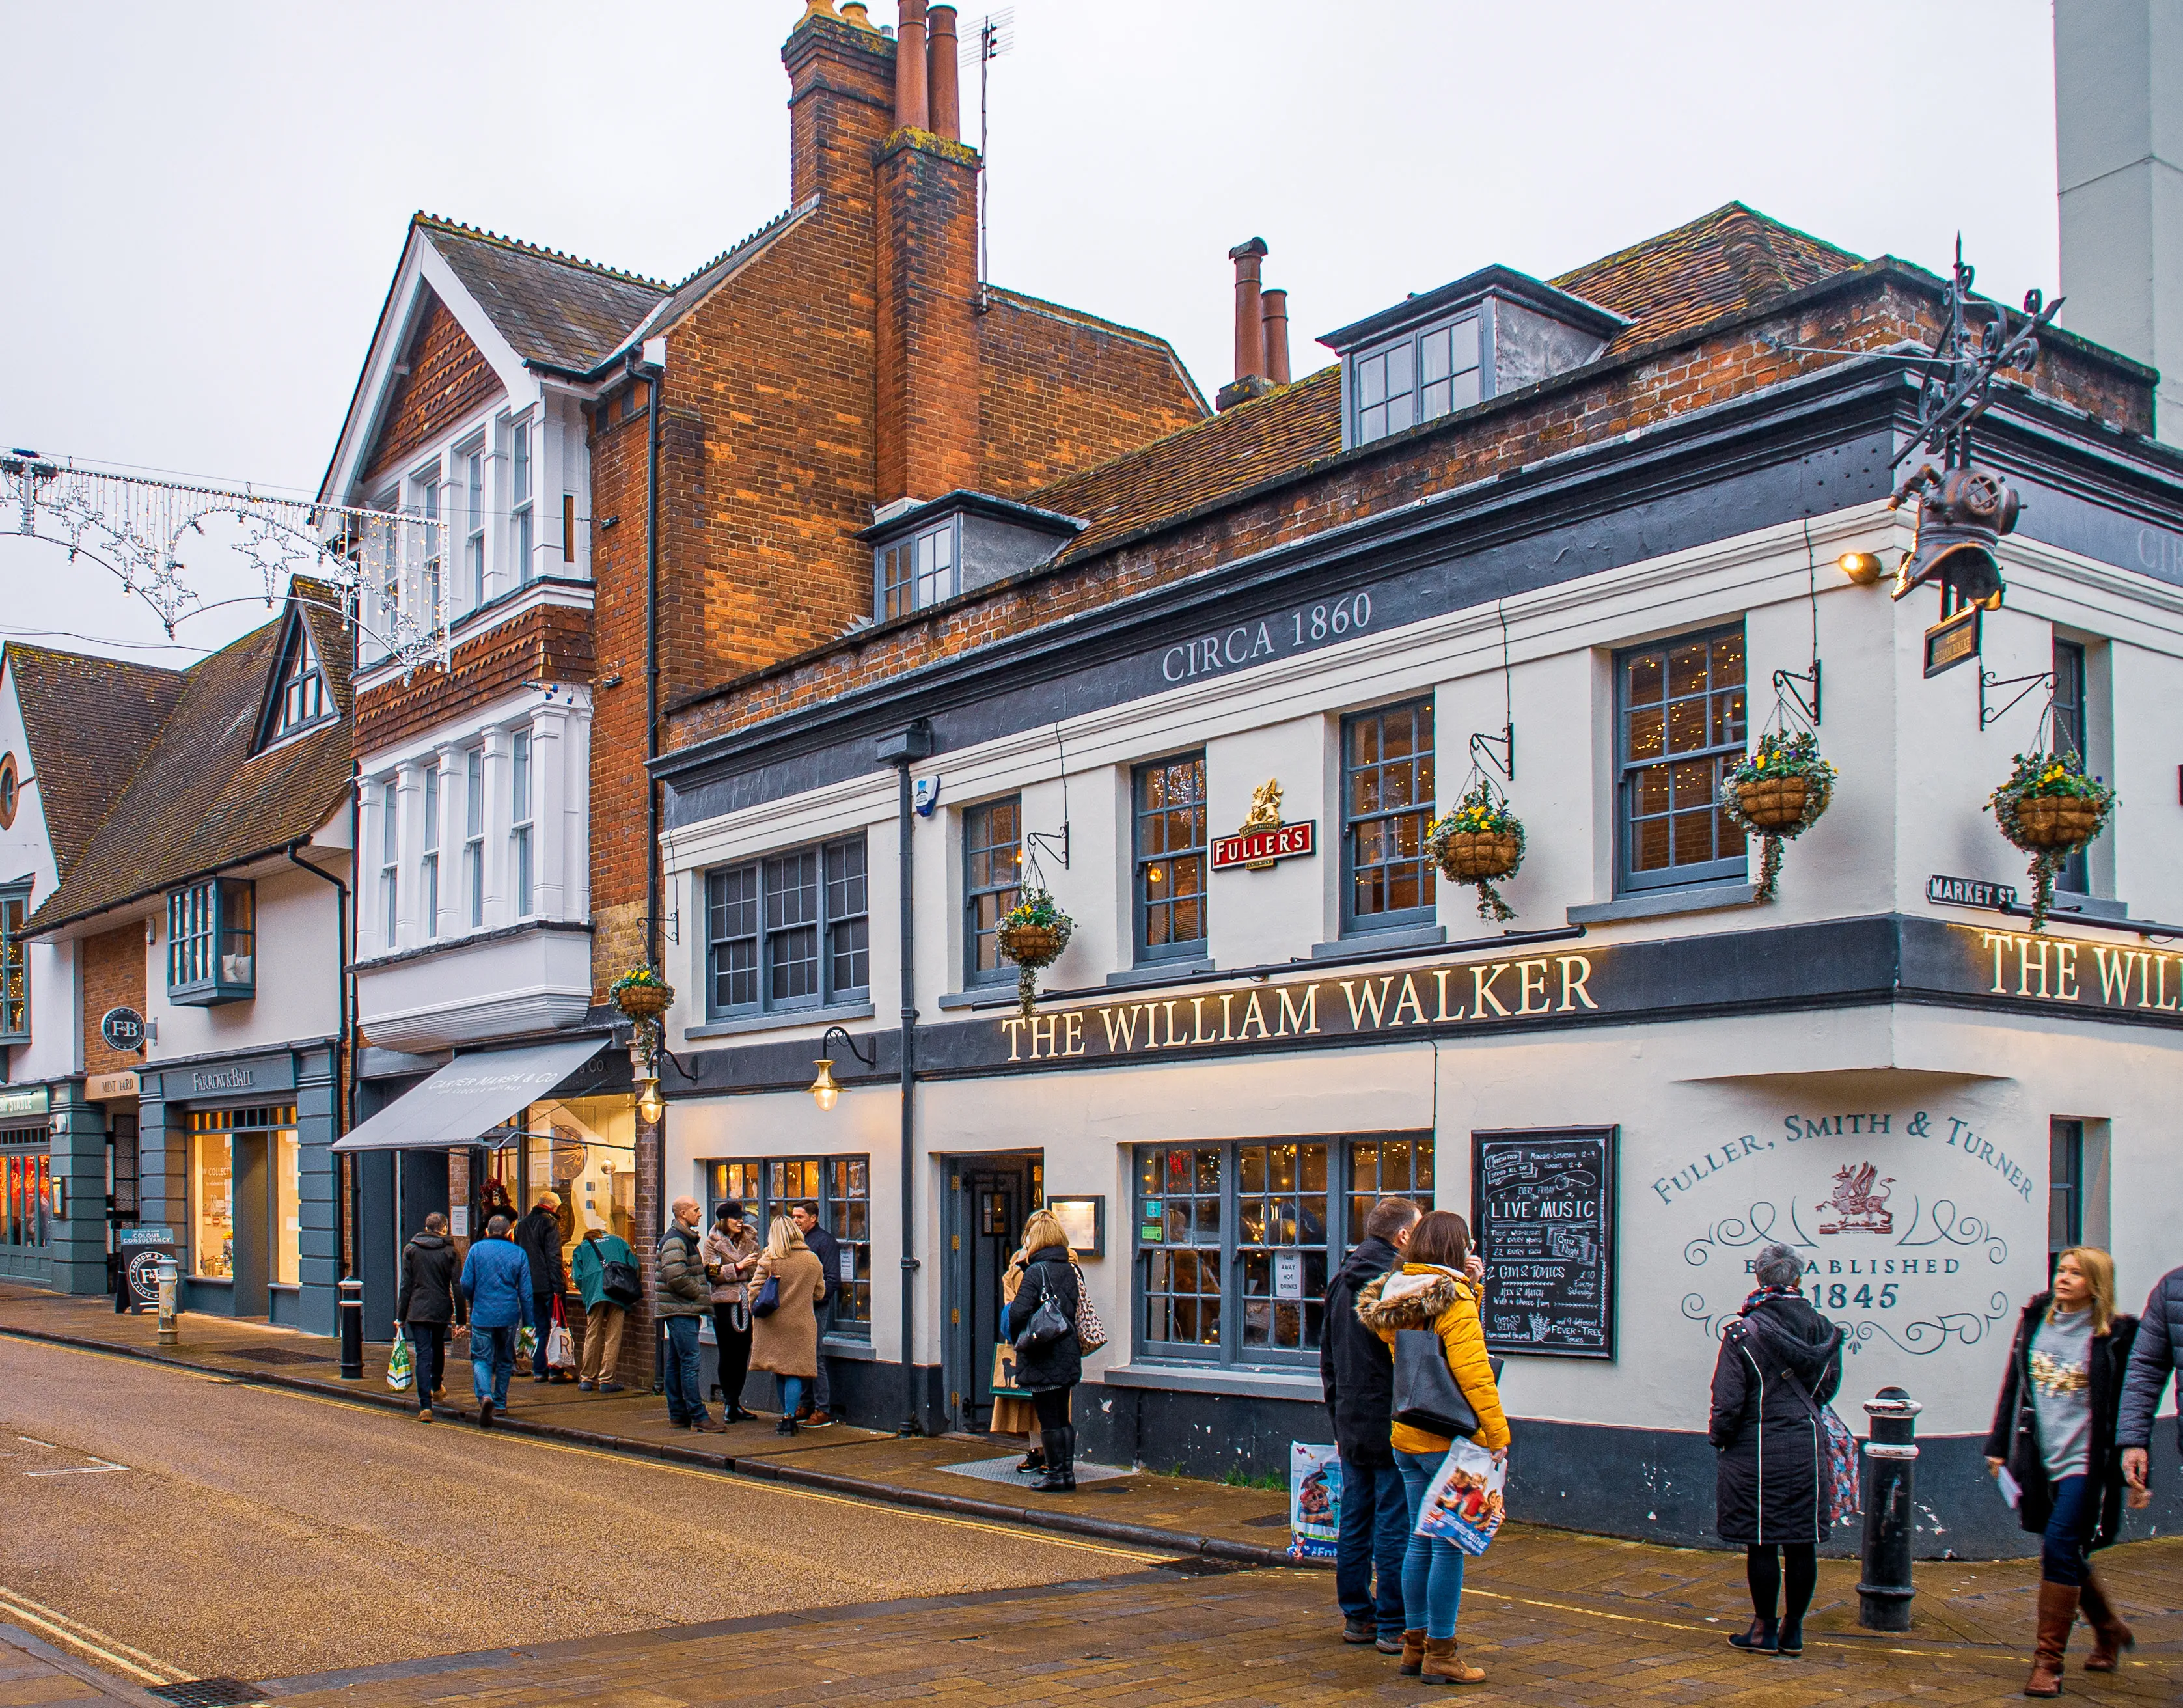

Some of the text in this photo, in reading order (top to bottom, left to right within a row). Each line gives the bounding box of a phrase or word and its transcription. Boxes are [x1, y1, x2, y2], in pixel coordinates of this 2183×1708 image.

[1163, 592, 1371, 682] CIRCA 1860
[1215, 827, 1304, 863] FULLER'S
[1932, 877, 1994, 905] MARKET
[1984, 931, 2183, 1012] THE WIL
[1002, 954, 1599, 1062] THE WILLIAM WALKER
[112, 1021, 139, 1037] F&B
[102, 1078, 134, 1094] MINT YARD
[428, 1072, 558, 1090] CARTER MARSH & CO
[1651, 1110, 2034, 1205] FULLER, SMITH & TURNER
[1491, 1200, 1595, 1218] LIVE MUSIC
[131, 1253, 152, 1273] FARROW
[1499, 1265, 1519, 1280] GIN
[1530, 1265, 1565, 1279] TONICS
[1743, 1258, 1960, 1274] EABLISHED
[133, 1281, 152, 1297] PAINT
[1811, 1283, 1900, 1310] 1845
